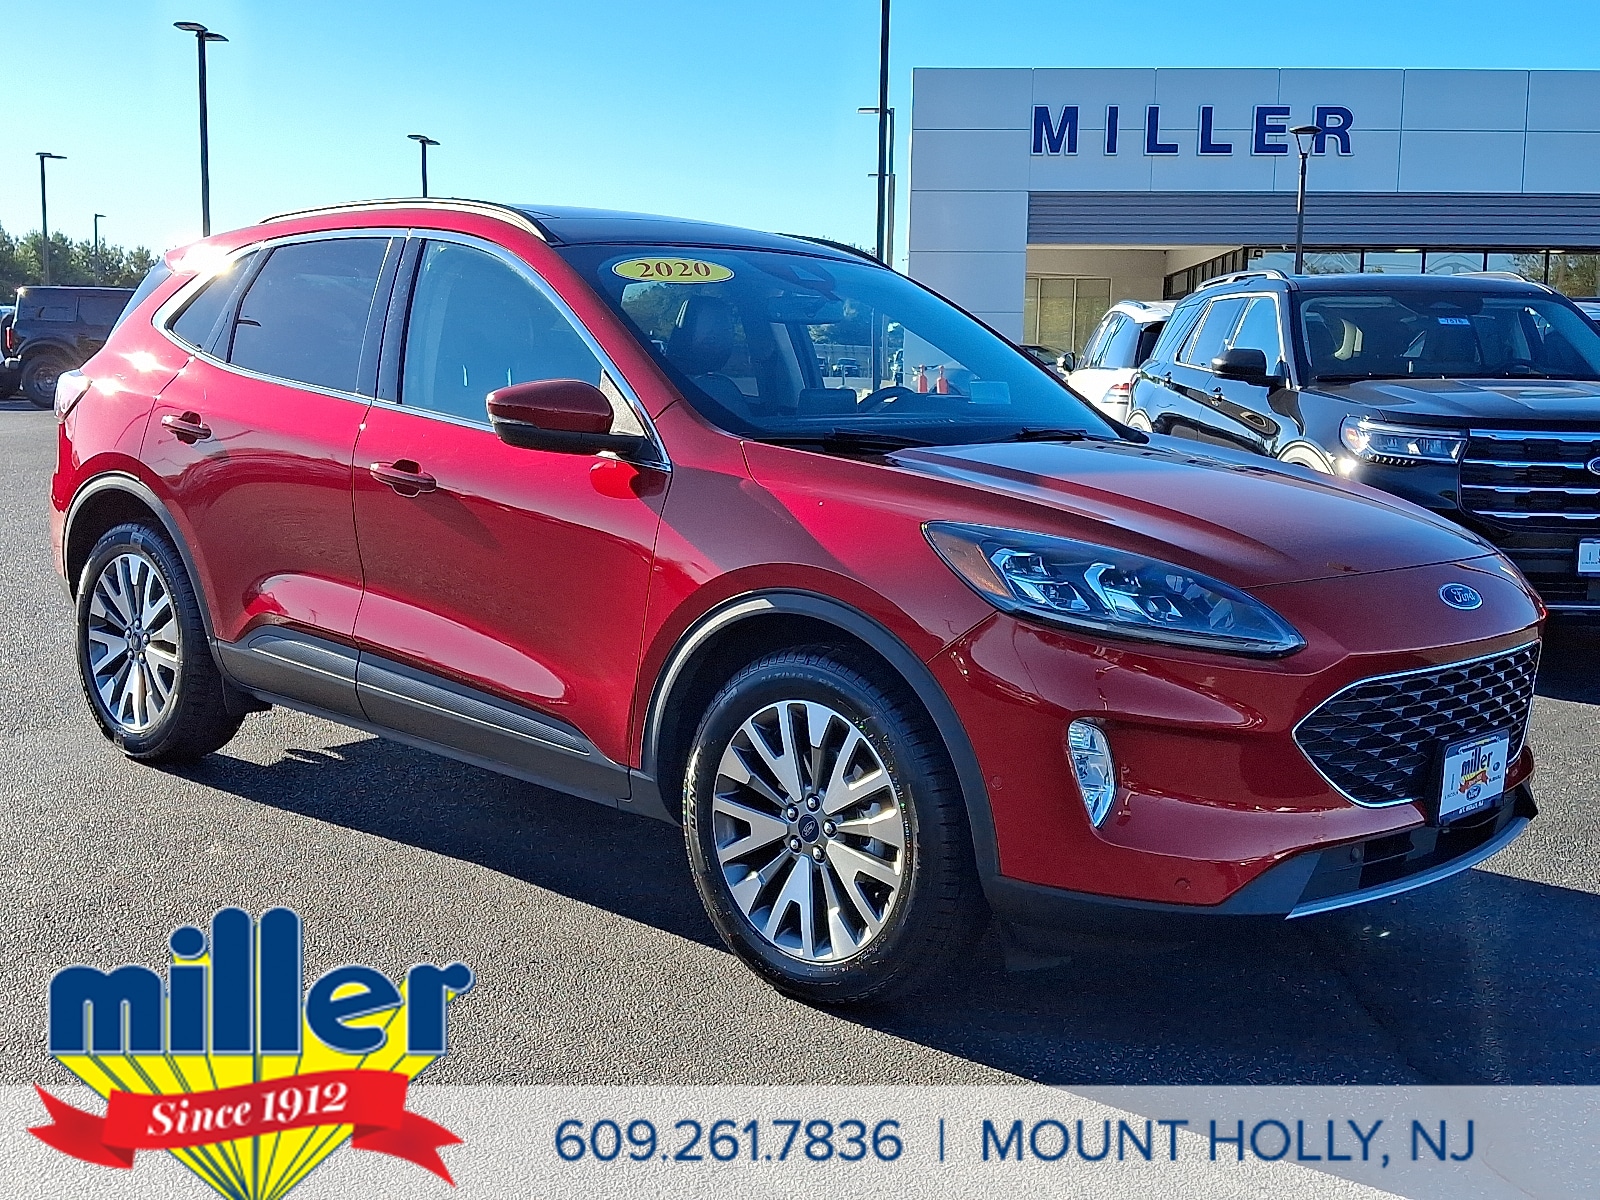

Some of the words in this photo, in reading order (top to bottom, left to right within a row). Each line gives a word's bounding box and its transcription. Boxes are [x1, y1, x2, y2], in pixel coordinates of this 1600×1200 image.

[1031, 104, 1354, 155] MILLER
[635, 261, 711, 278] 2020
[1451, 588, 1476, 602] Ford
[1461, 747, 1493, 776] miller
